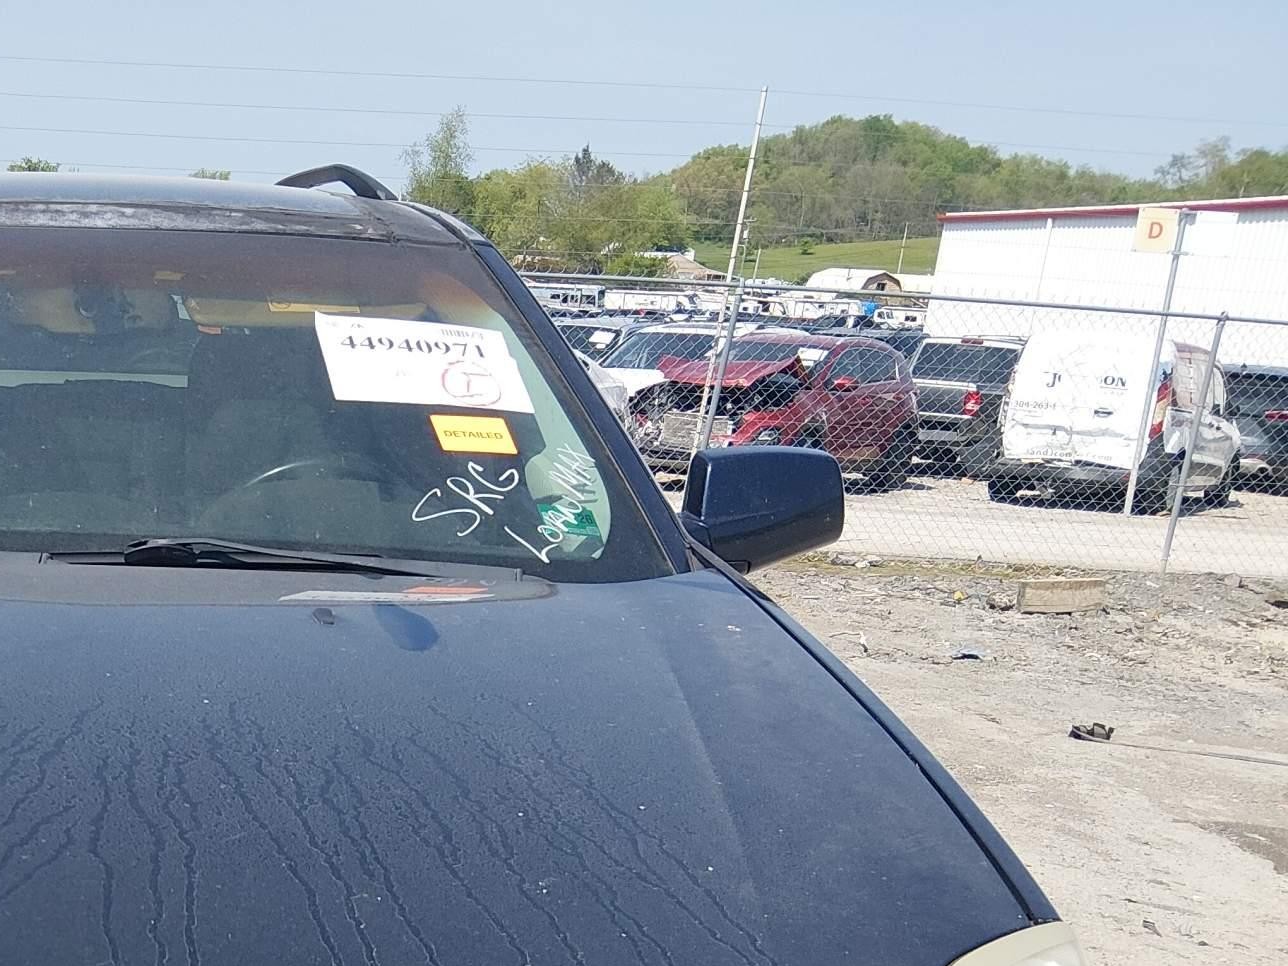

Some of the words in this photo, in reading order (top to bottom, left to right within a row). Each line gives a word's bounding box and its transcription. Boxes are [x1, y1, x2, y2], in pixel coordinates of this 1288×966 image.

[1148, 221, 1164, 239] D
[340, 335, 485, 358] 44940971
[443, 429, 504, 440] DETAILED
[412, 461, 520, 537] SRG
